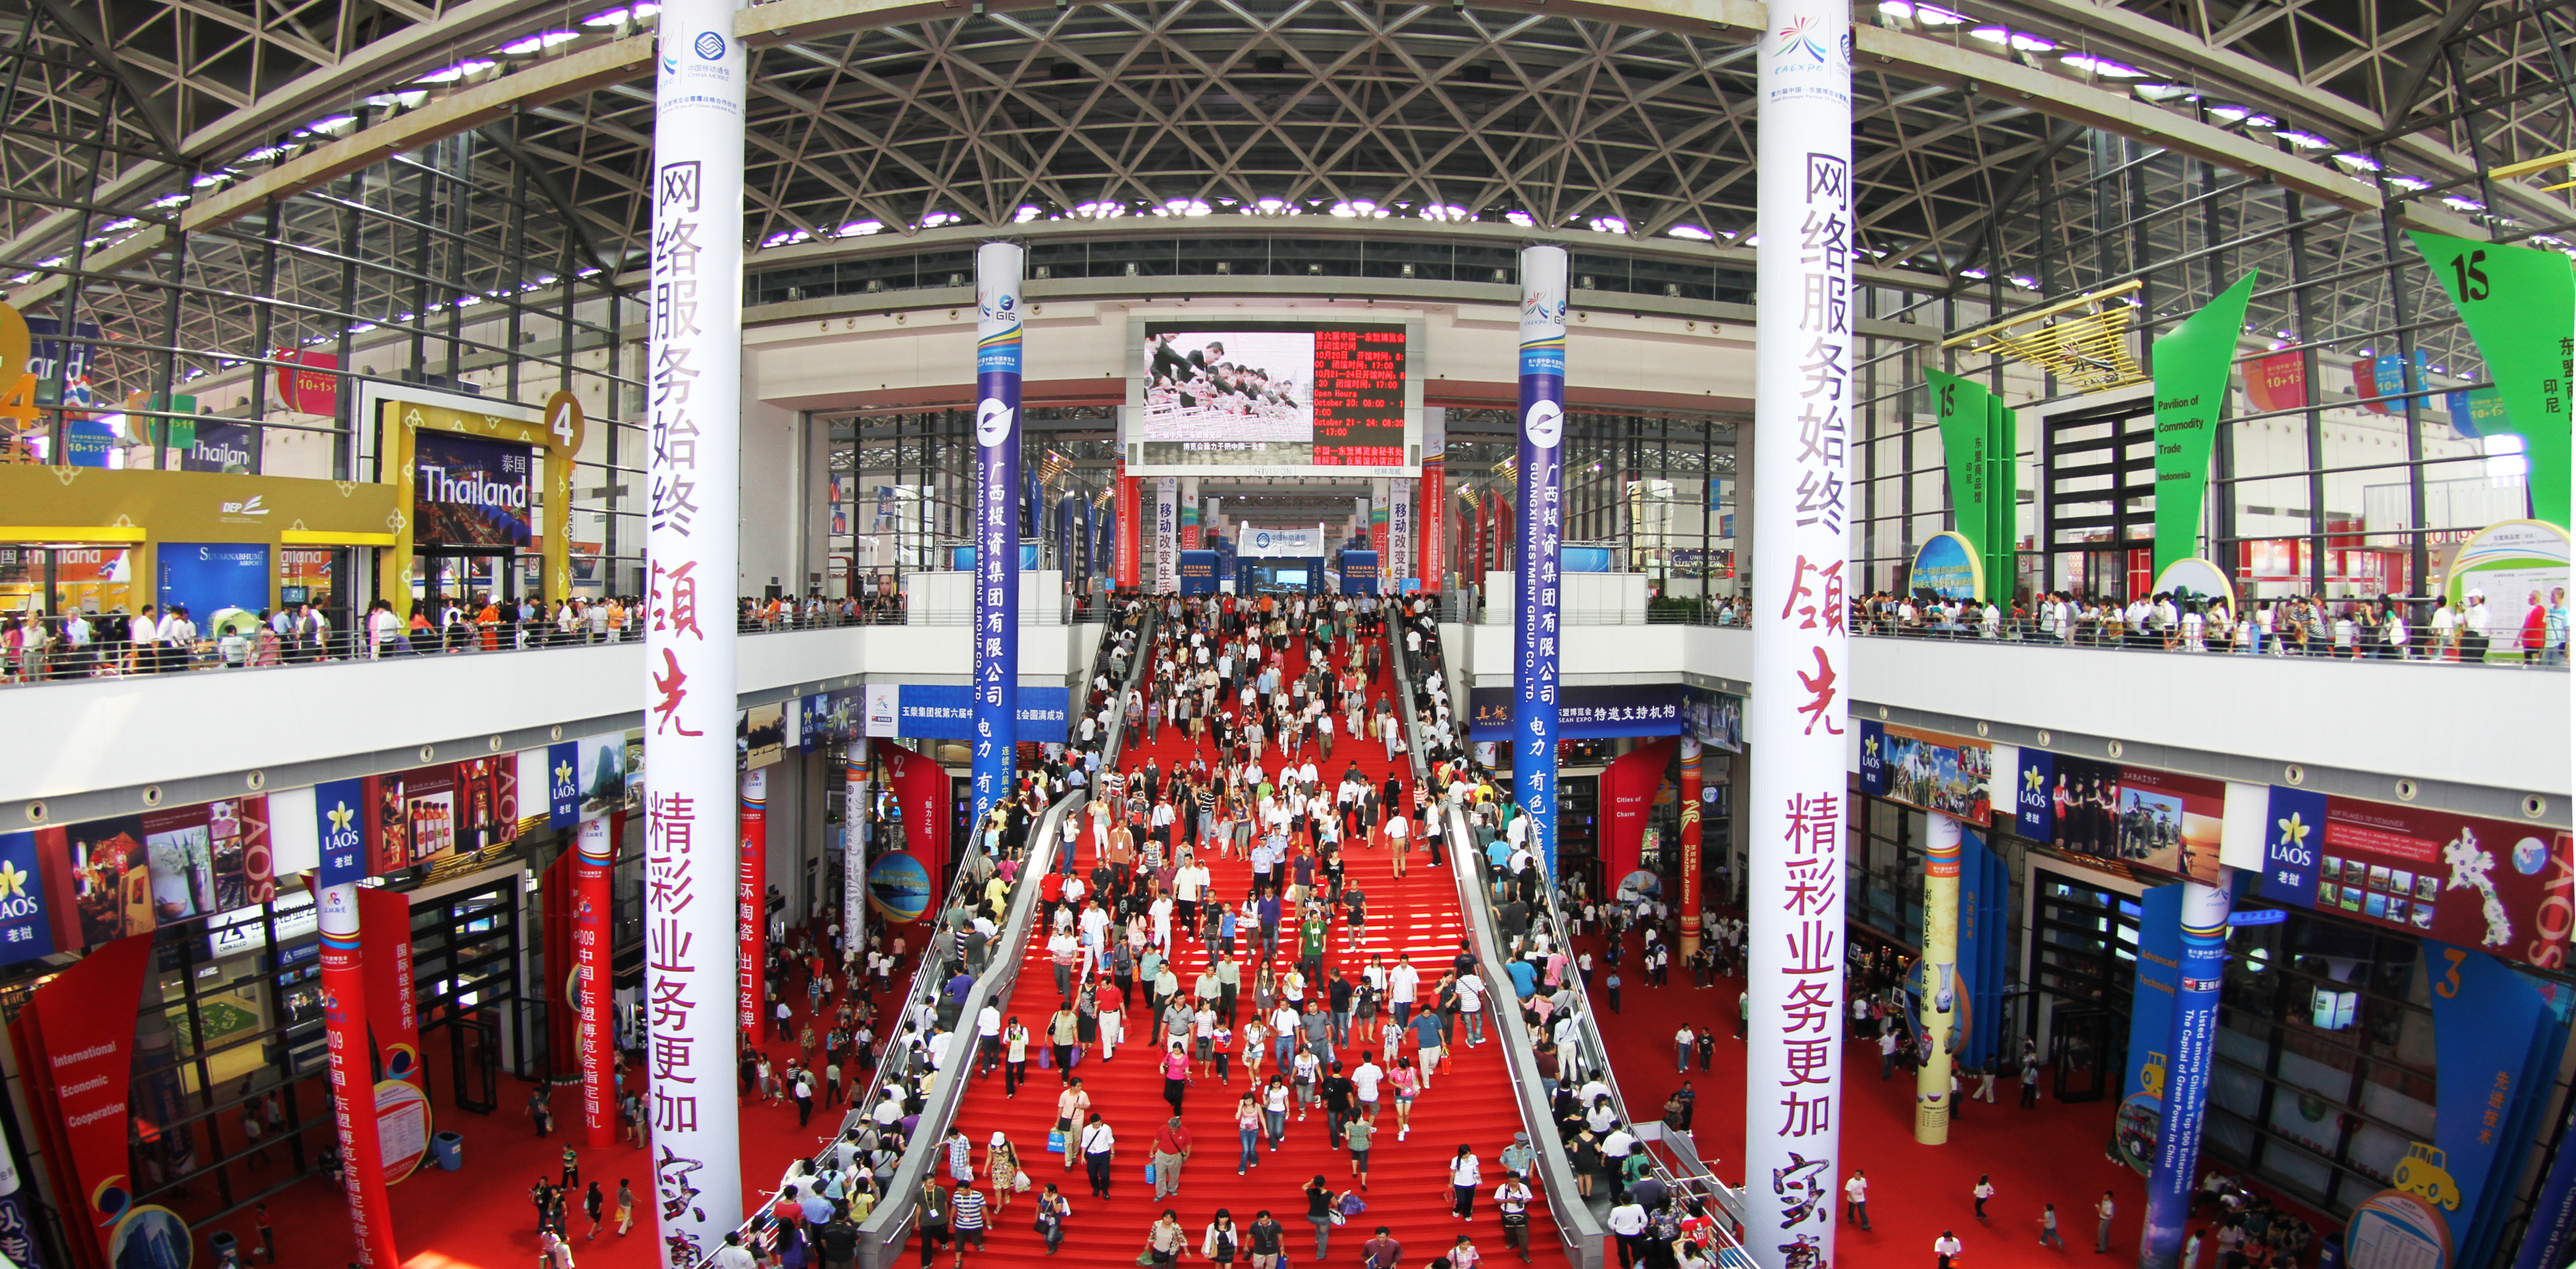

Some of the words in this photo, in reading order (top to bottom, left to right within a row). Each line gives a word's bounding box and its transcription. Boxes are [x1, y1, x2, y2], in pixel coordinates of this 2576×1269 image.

[687, 64, 730, 76] 中国移动通信
[709, 74, 729, 82] MOBILE
[1774, 63, 1824, 75] CAEXPO
[2450, 249, 2489, 303] 15
[996, 311, 1015, 321] GIG
[1315, 331, 1406, 343] 第六届中国—东盟博览会
[1315, 341, 1357, 351] 开闭馆时间
[1315, 351, 1348, 360] 10月20日
[1313, 398, 1343, 407] October
[1345, 399, 1358, 407] 20:
[1362, 399, 1385, 408] 08:00
[1314, 389, 1333, 398] Open
[1334, 389, 1358, 398] Hours
[1939, 383, 1955, 418] 15
[2158, 398, 2189, 410] Pavilion
[2190, 395, 2199, 405] of
[2543, 379, 2561, 414] 印尼
[1313, 418, 1343, 426] October
[1365, 419, 1379, 427] 24:
[1382, 419, 1405, 428] 08:30
[1314, 408, 1333, 417] 7:00
[553, 402, 574, 447] 4
[2158, 418, 2204, 433] Commodity
[1313, 446, 1404, 457] 中国—东盟博览会秘书处
[2158, 443, 2182, 454] Trade
[501, 454, 526, 474] 泰国
[1966, 462, 1972, 484] 印尼
[1974, 436, 1982, 504] 东盟商品馆
[420, 465, 526, 508] Thailand
[2159, 470, 2191, 481] Indonesia
[976, 462, 985, 520] GUANGXI
[1528, 462, 1539, 520] GUANGXI
[223, 502, 243, 513] DEP
[1159, 502, 1172, 596] 移动改变生活
[976, 522, 984, 603] INVESTMENT
[1527, 522, 1537, 603] INVESTMENT
[985, 461, 1006, 707] 广西投资集团有限公司
[1539, 462, 1559, 706] 广西投资集团有限公司
[1526, 604, 1536, 648] GROUP
[1525, 677, 1534, 703] LTD.
[1594, 704, 1676, 721] 特邀支持机构
[802, 724, 814, 735] LAOS
[977, 717, 992, 758] 电力
[1529, 716, 1546, 757] 电力
[894, 755, 905, 777] 2
[1862, 755, 1880, 770] LAOS
[1866, 773, 1876, 783] 老挝
[498, 752, 518, 842] LAOS
[552, 783, 575, 800] LAOS
[2019, 791, 2046, 808] LAOS
[559, 803, 571, 815] 老挝
[2025, 812, 2040, 824] 老挝
[239, 792, 275, 905] LAOS
[325, 830, 359, 851] LAOS
[334, 855, 353, 869] 老挝
[2271, 843, 2312, 867] LAOS
[2277, 870, 2301, 888] 老挝
[740, 862, 754, 942] 三环陶瓷
[2528, 830, 2575, 969] LAOS
[7, 925, 34, 943] 老挝
[219, 940, 248, 952] CHINALCO
[2141, 950, 2178, 969] Advanced
[2435, 948, 2468, 999] 3
[396, 943, 413, 1031] 国际经济合作
[740, 952, 756, 1029] 出口名牌
[2139, 974, 2176, 997] Technolog
[2184, 1010, 2194, 1027] The
[2196, 1010, 2209, 1039] Listed
[54, 1040, 117, 1068] International
[2179, 1029, 2192, 1062] Capital
[2190, 1040, 2205, 1074] among
[2180, 1063, 2187, 1074] of
[60, 1074, 109, 1098] Economic
[2173, 1075, 2186, 1103] Green
[2186, 1075, 2200, 1110] Chinese
[69, 1102, 126, 1128] Cooperation
[2170, 1104, 2182, 1133] Power
[2476, 1071, 2511, 1145] 先进技术
[2183, 1111, 2194, 1128] Top
[2168, 1134, 2177, 1143] in
[2182, 1131, 2191, 1146] 500
[2164, 1144, 2176, 1168] China
[2173, 1148, 2189, 1195] Enterprises
